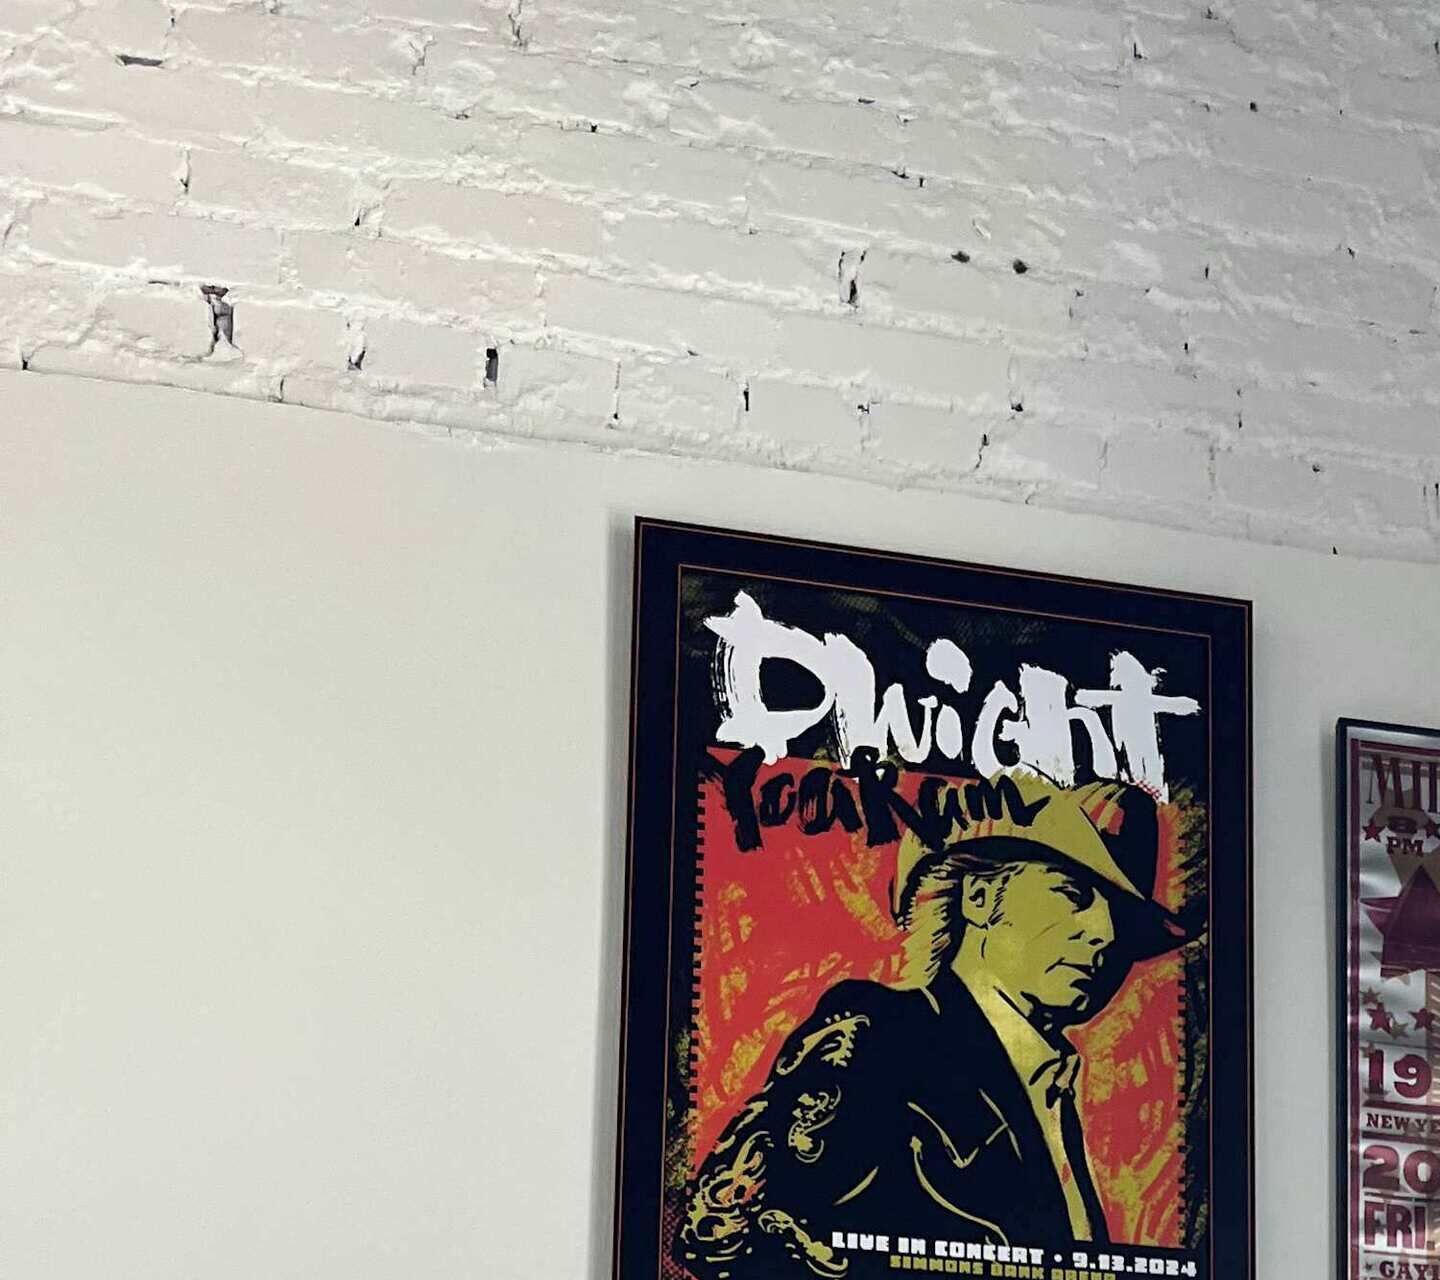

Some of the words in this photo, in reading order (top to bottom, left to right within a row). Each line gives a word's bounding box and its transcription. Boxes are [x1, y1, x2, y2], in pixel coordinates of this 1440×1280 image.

[1366, 1113, 1410, 1132] NEW
[832, 1232, 889, 1252] LIVE
[898, 1238, 926, 1255] IN
[935, 1240, 1044, 1265] CONCERT
